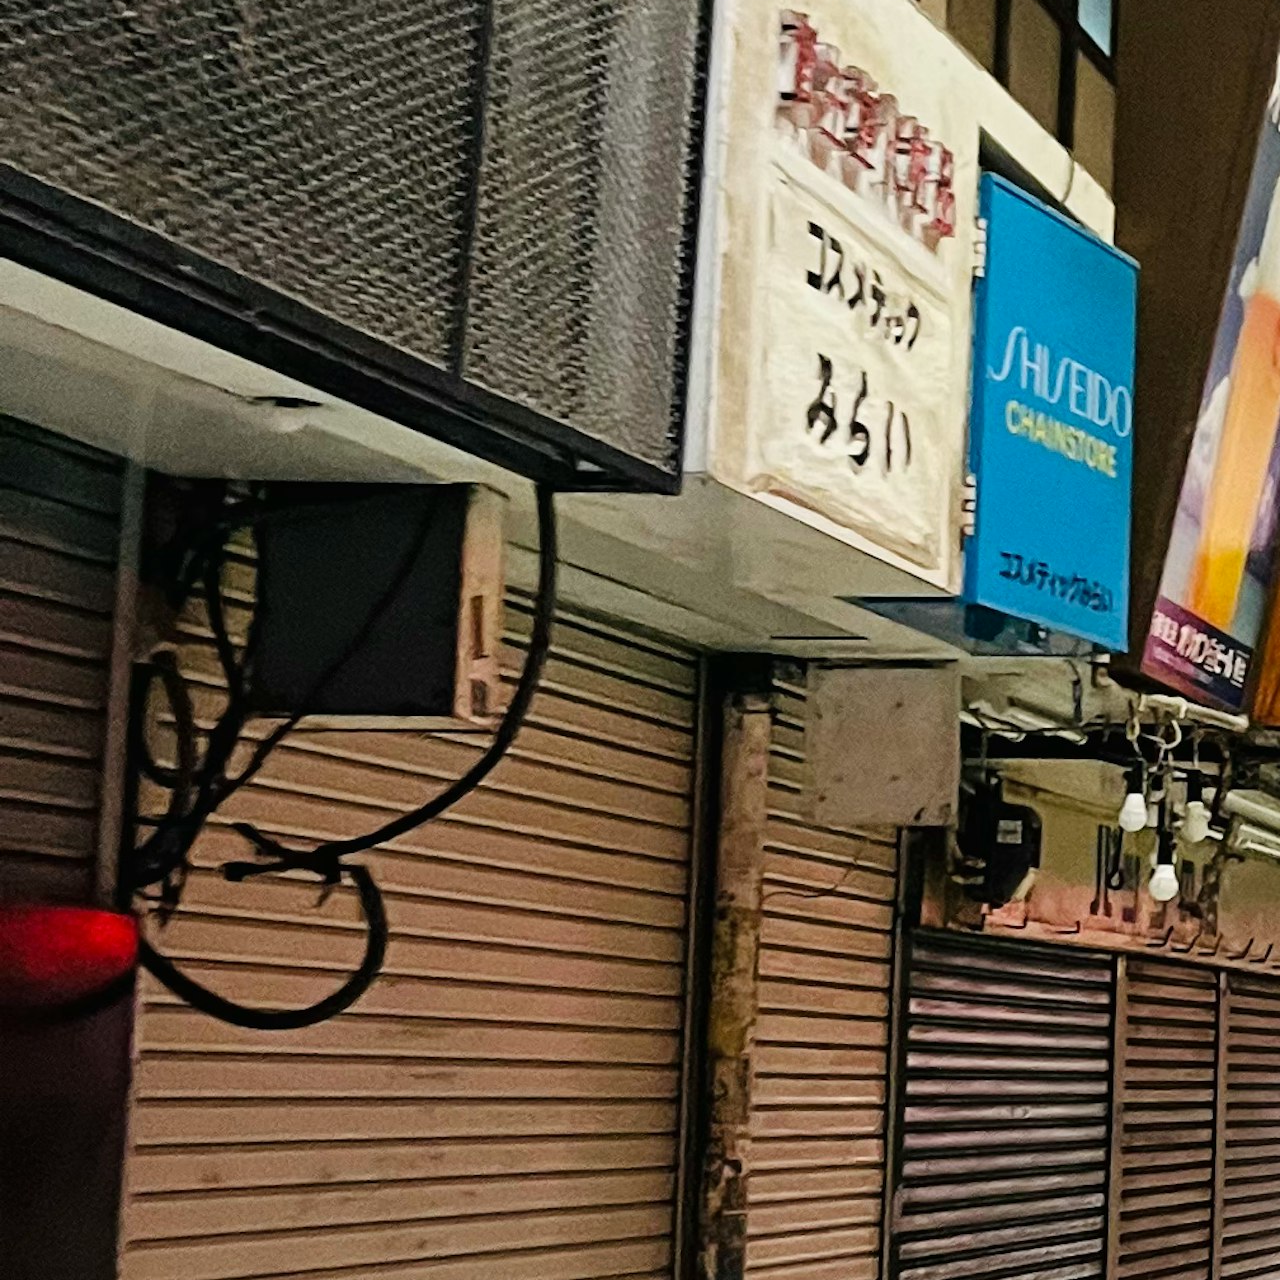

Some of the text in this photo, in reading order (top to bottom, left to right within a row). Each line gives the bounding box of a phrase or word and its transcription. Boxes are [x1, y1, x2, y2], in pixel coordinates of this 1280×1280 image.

[805, 220, 920, 352] コスメティック
[806, 352, 912, 472] みらい
[986, 326, 1132, 437] SHISEIDO
[1006, 400, 1117, 478] CHAINSTORE
